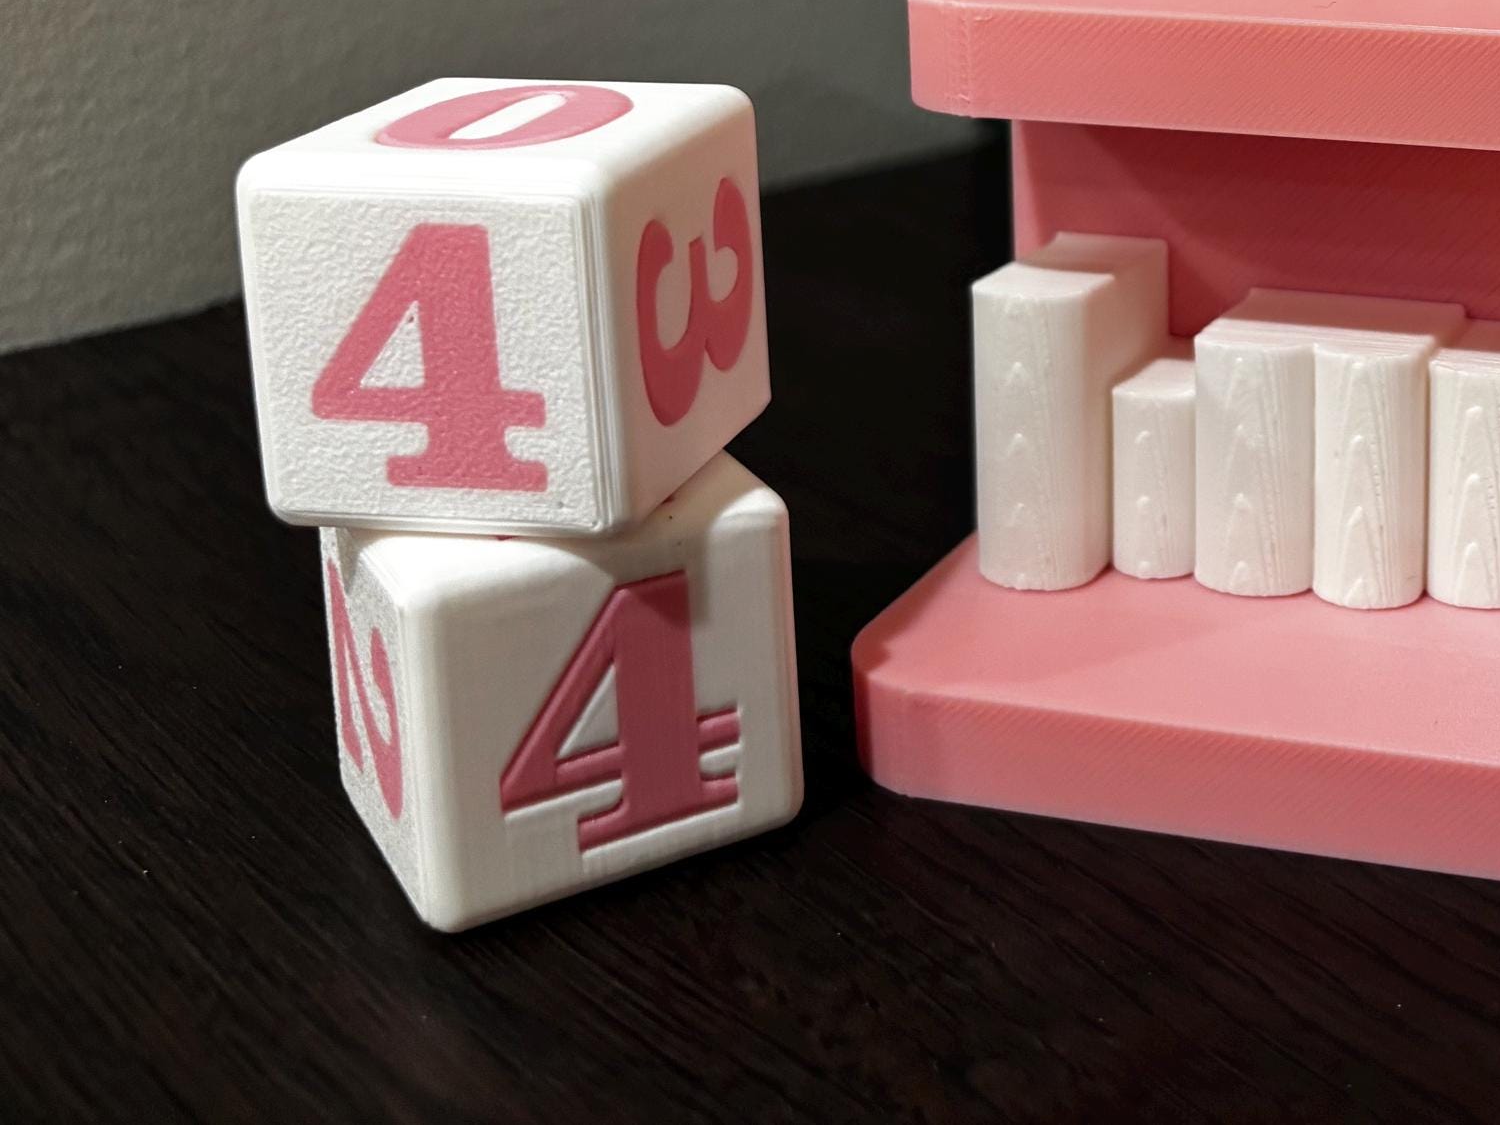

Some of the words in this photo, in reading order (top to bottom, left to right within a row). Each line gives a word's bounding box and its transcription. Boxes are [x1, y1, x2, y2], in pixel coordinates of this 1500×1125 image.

[311, 222, 547, 492] 4
[636, 177, 753, 427] 3
[500, 570, 740, 854] 4
